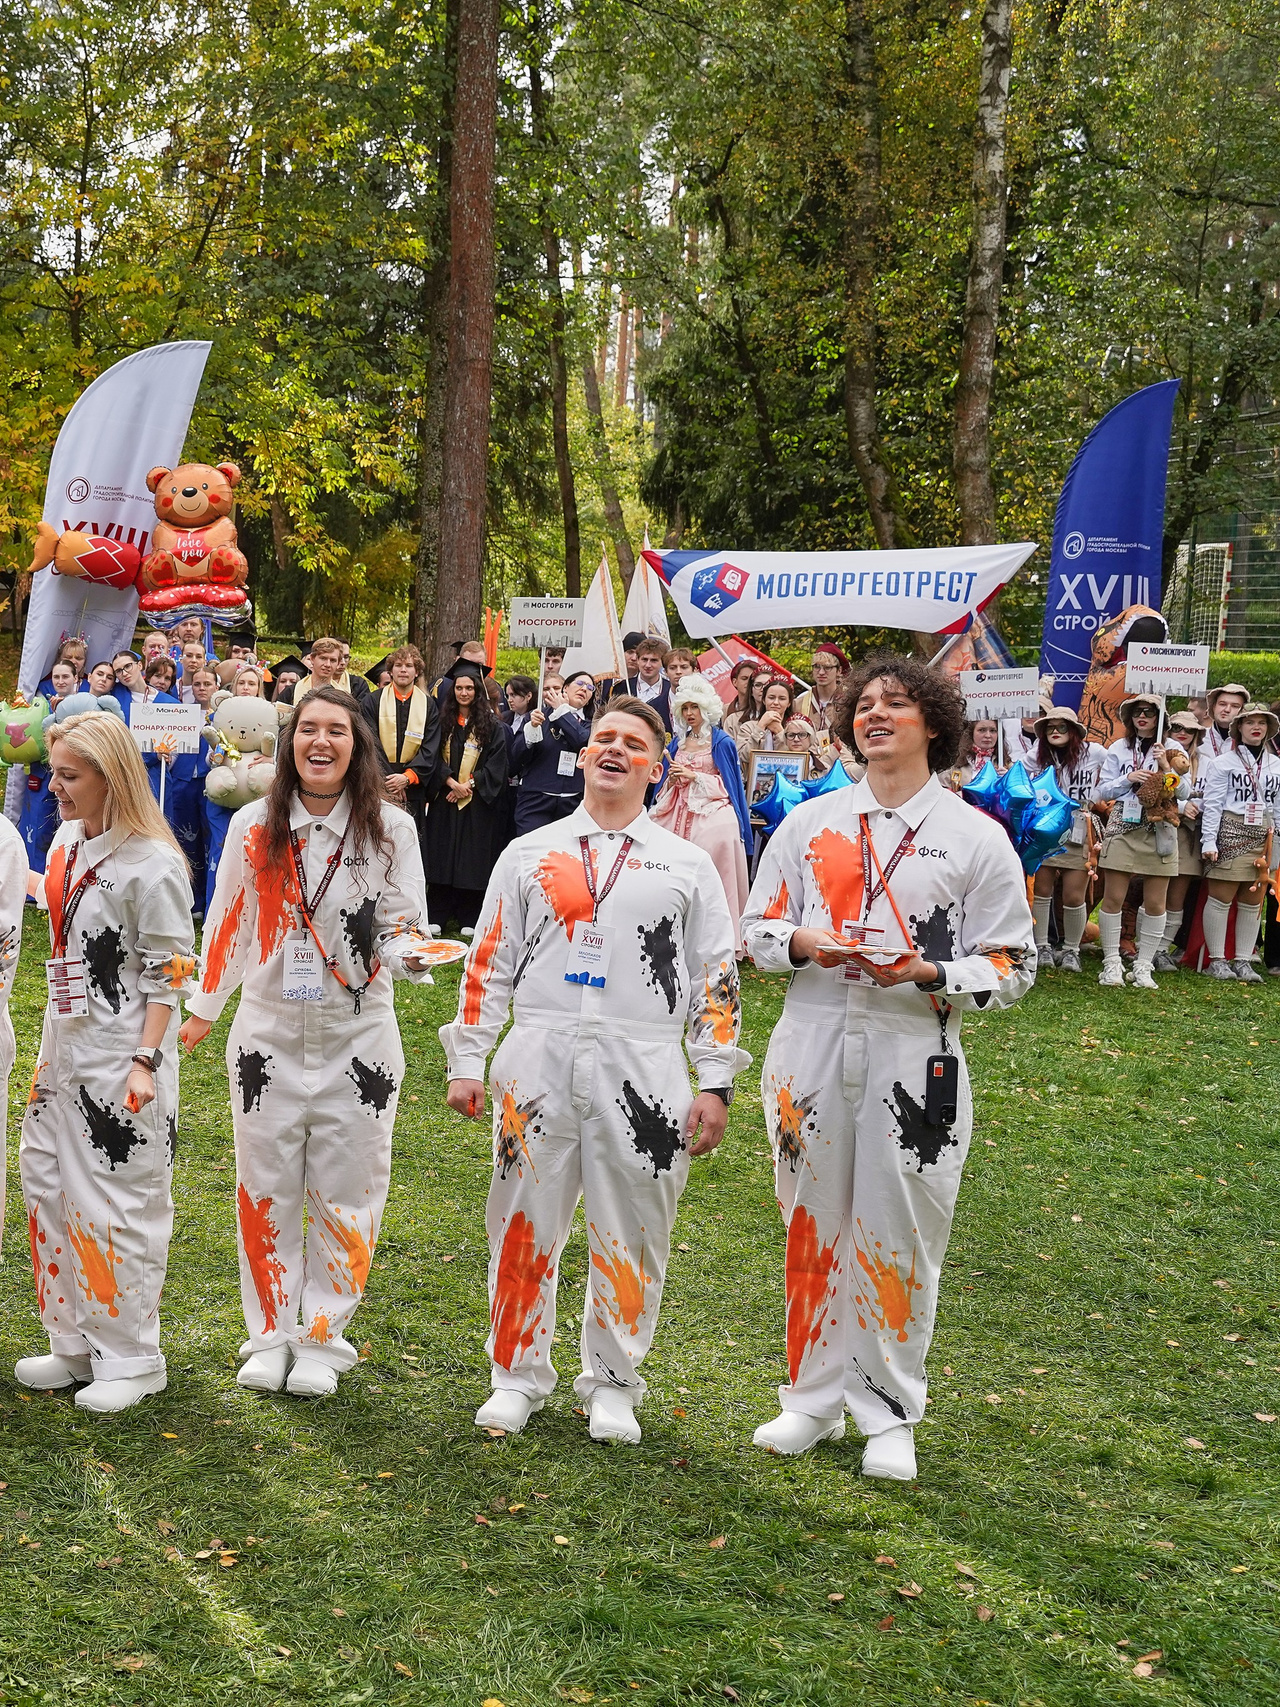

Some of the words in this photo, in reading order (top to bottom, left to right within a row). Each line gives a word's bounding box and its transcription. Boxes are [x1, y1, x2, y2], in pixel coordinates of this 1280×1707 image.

[177, 537, 204, 549] love
[181, 549, 206, 562] you
[756, 571, 978, 604] МОСГОРГЕОТРЕСТ
[1056, 573, 1150, 610] XVIII
[518, 618, 577, 626] МОСГОРБТИ
[1149, 647, 1197, 657] МОСИНЖПРОЕКТ
[987, 672, 1024, 681] МОСГОРГЕОТРЕСТ
[1131, 665, 1206, 675] МОСИНЖПРОЕКТ
[965, 689, 1036, 699] МОСГОРГЕОТРЕСТ
[133, 724, 197, 732] МОНАРХ-ПРОЕКТ
[582, 848, 590, 865] ГОРОДА
[918, 846, 949, 860] ФСК
[343, 855, 370, 868] ФСК
[643, 860, 671, 872] ФСК
[882, 852, 901, 880] ФУНДАМЕН
[585, 865, 594, 889] ФУНДАМЕНТ
[607, 860, 622, 884] ФУНДАМЕНТ
[311, 878, 328, 906] ФУНДАМЕНТ
[325, 858, 337, 879] ГОРОДА
[582, 935, 604, 946] XVIII
